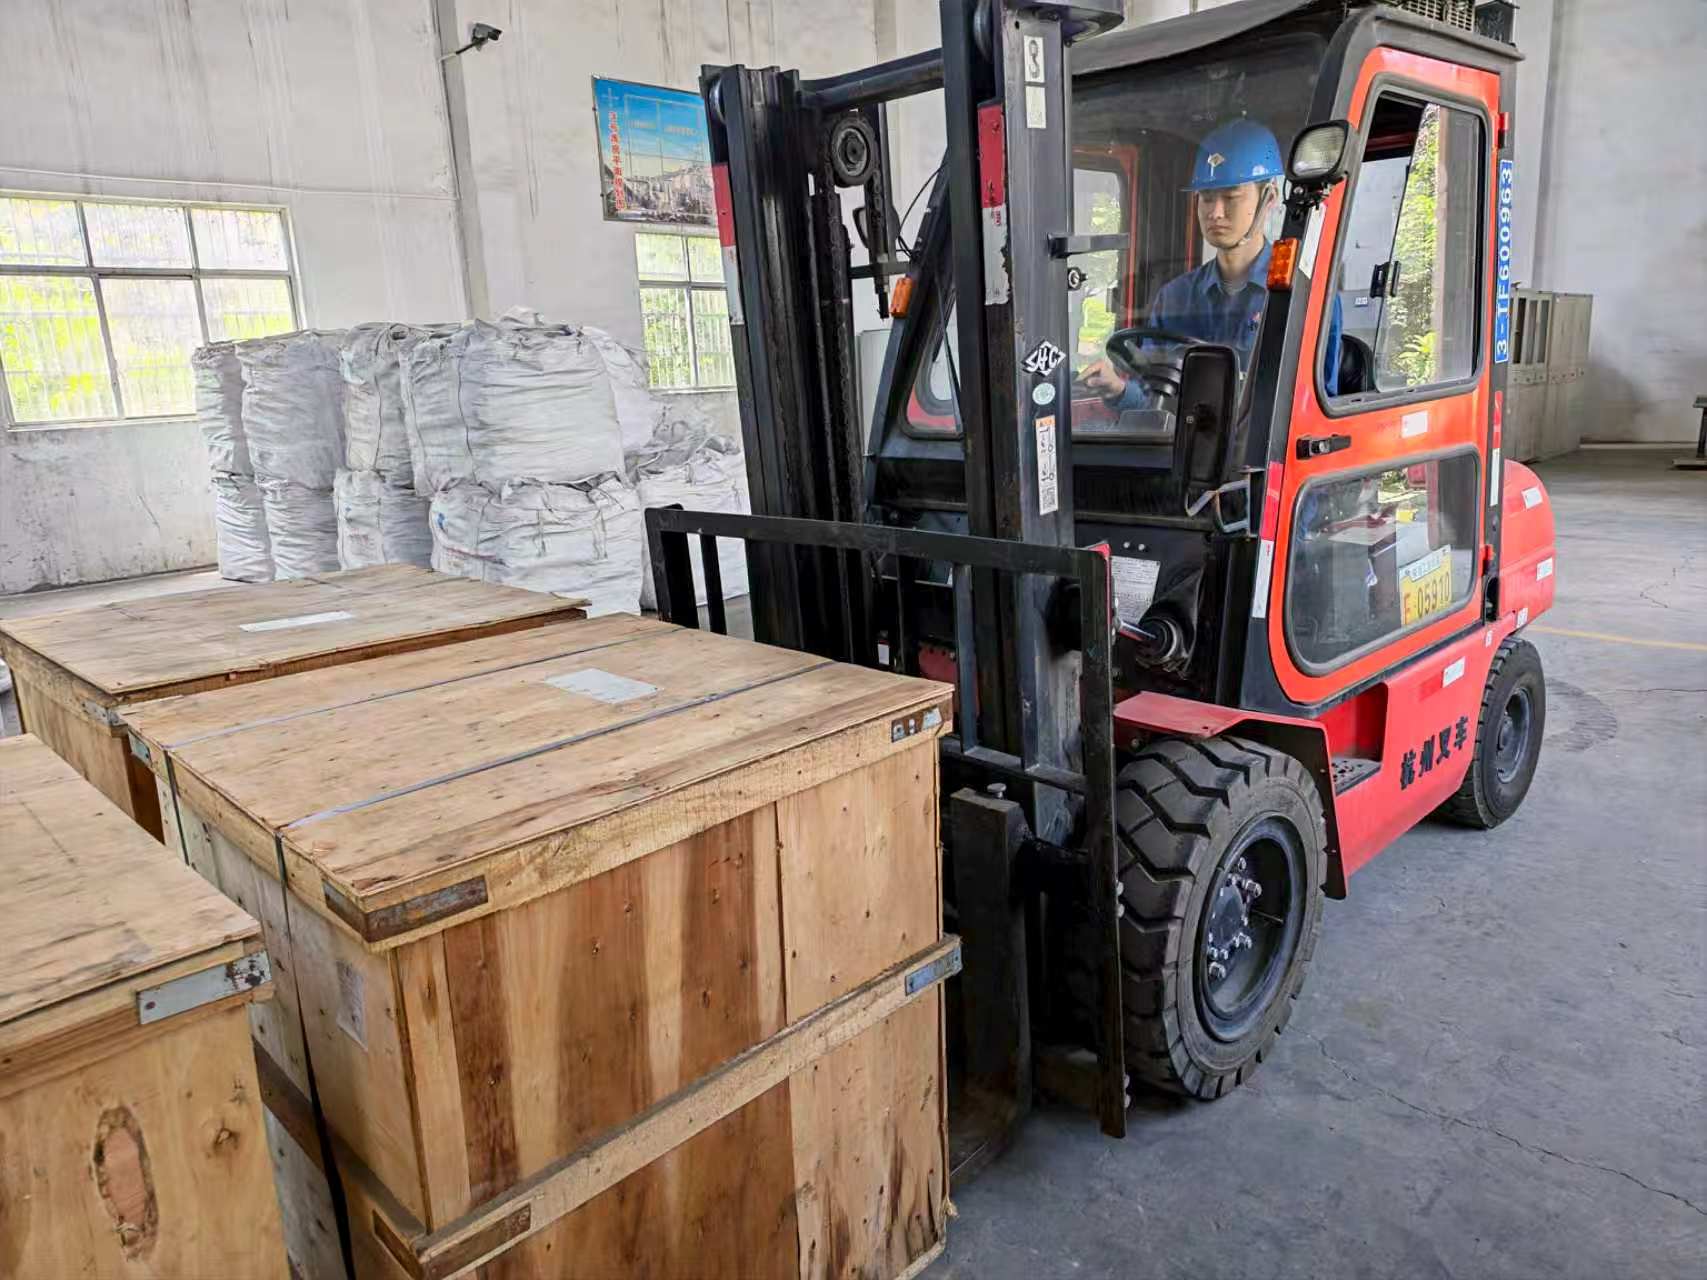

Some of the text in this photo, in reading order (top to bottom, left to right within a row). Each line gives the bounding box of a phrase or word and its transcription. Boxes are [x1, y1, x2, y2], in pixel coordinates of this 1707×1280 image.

[1496, 168, 1512, 354] 3-TF600963
[1400, 716, 1468, 790] 杭州叉车
